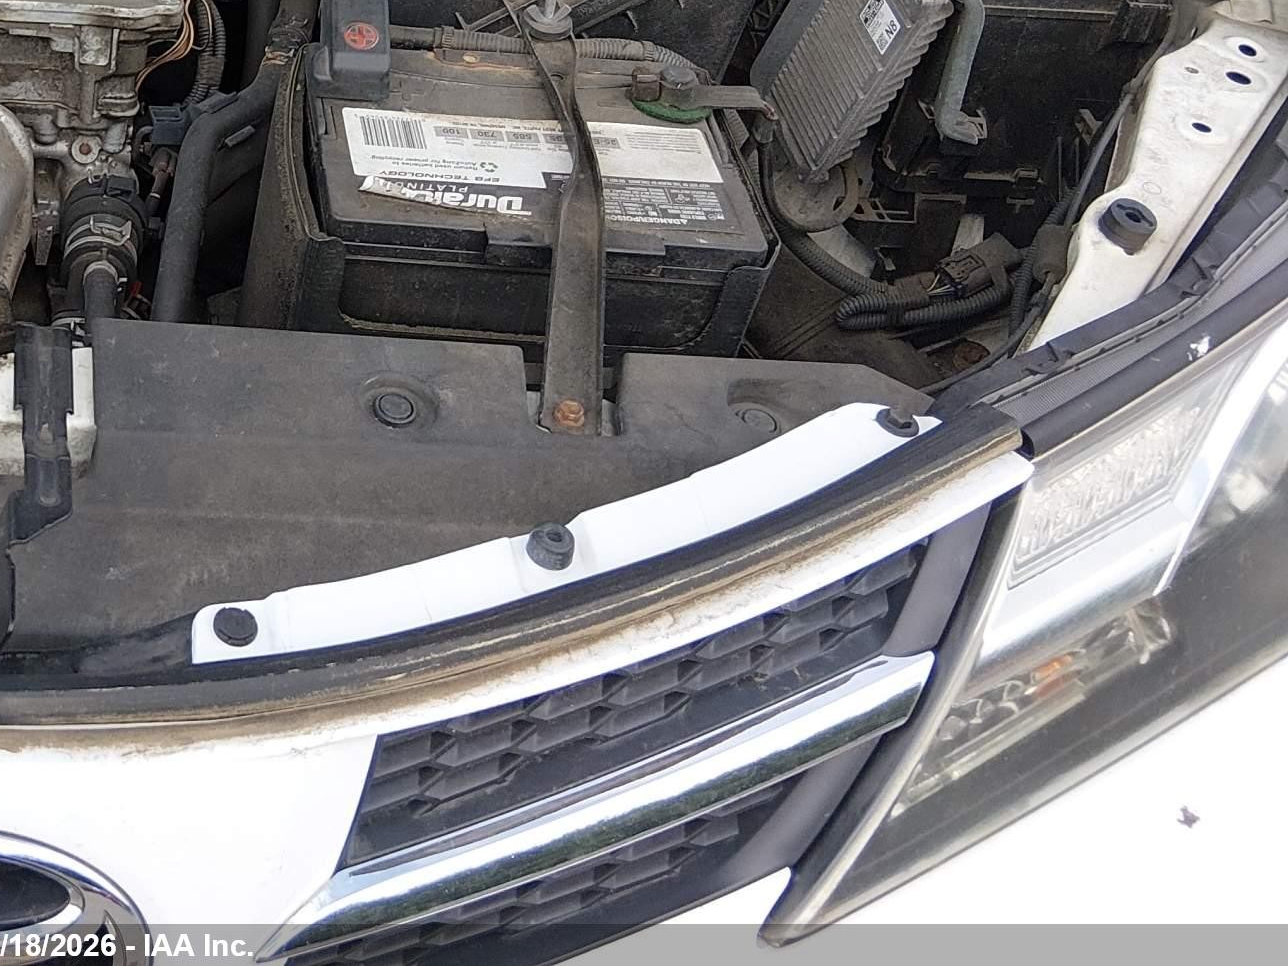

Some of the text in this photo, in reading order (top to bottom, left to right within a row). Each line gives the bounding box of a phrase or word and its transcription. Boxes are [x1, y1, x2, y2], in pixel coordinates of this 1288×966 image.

[442, 127, 460, 135] 100
[477, 130, 496, 138] 730
[379, 170, 473, 181] TECHNOLOGY
[398, 181, 469, 193] PLATIN
